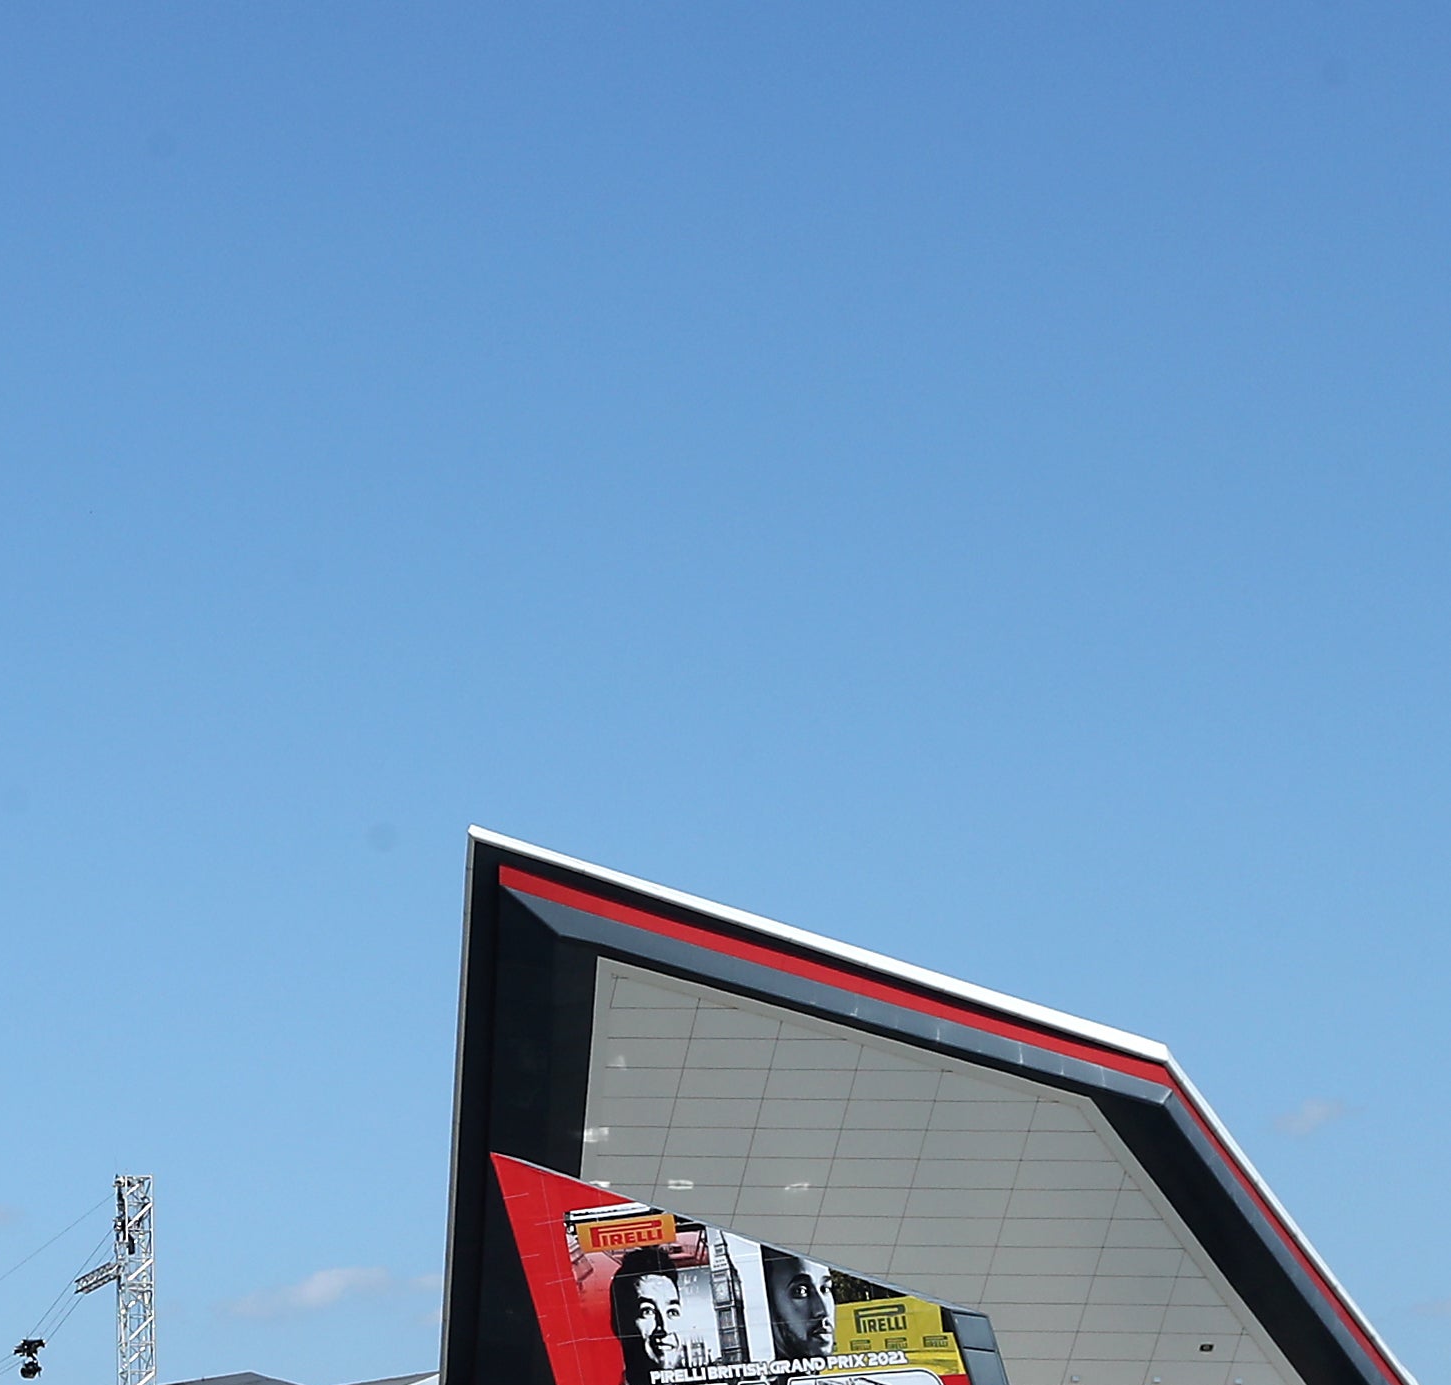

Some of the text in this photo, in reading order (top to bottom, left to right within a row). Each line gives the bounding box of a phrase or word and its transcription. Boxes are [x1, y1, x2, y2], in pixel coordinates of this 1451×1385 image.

[590, 1220, 663, 1248] PIRELLI
[854, 1304, 907, 1333] PIRELLI
[650, 1351, 908, 1384] PIRELLI BRITISH GRAND PRIX 2021
